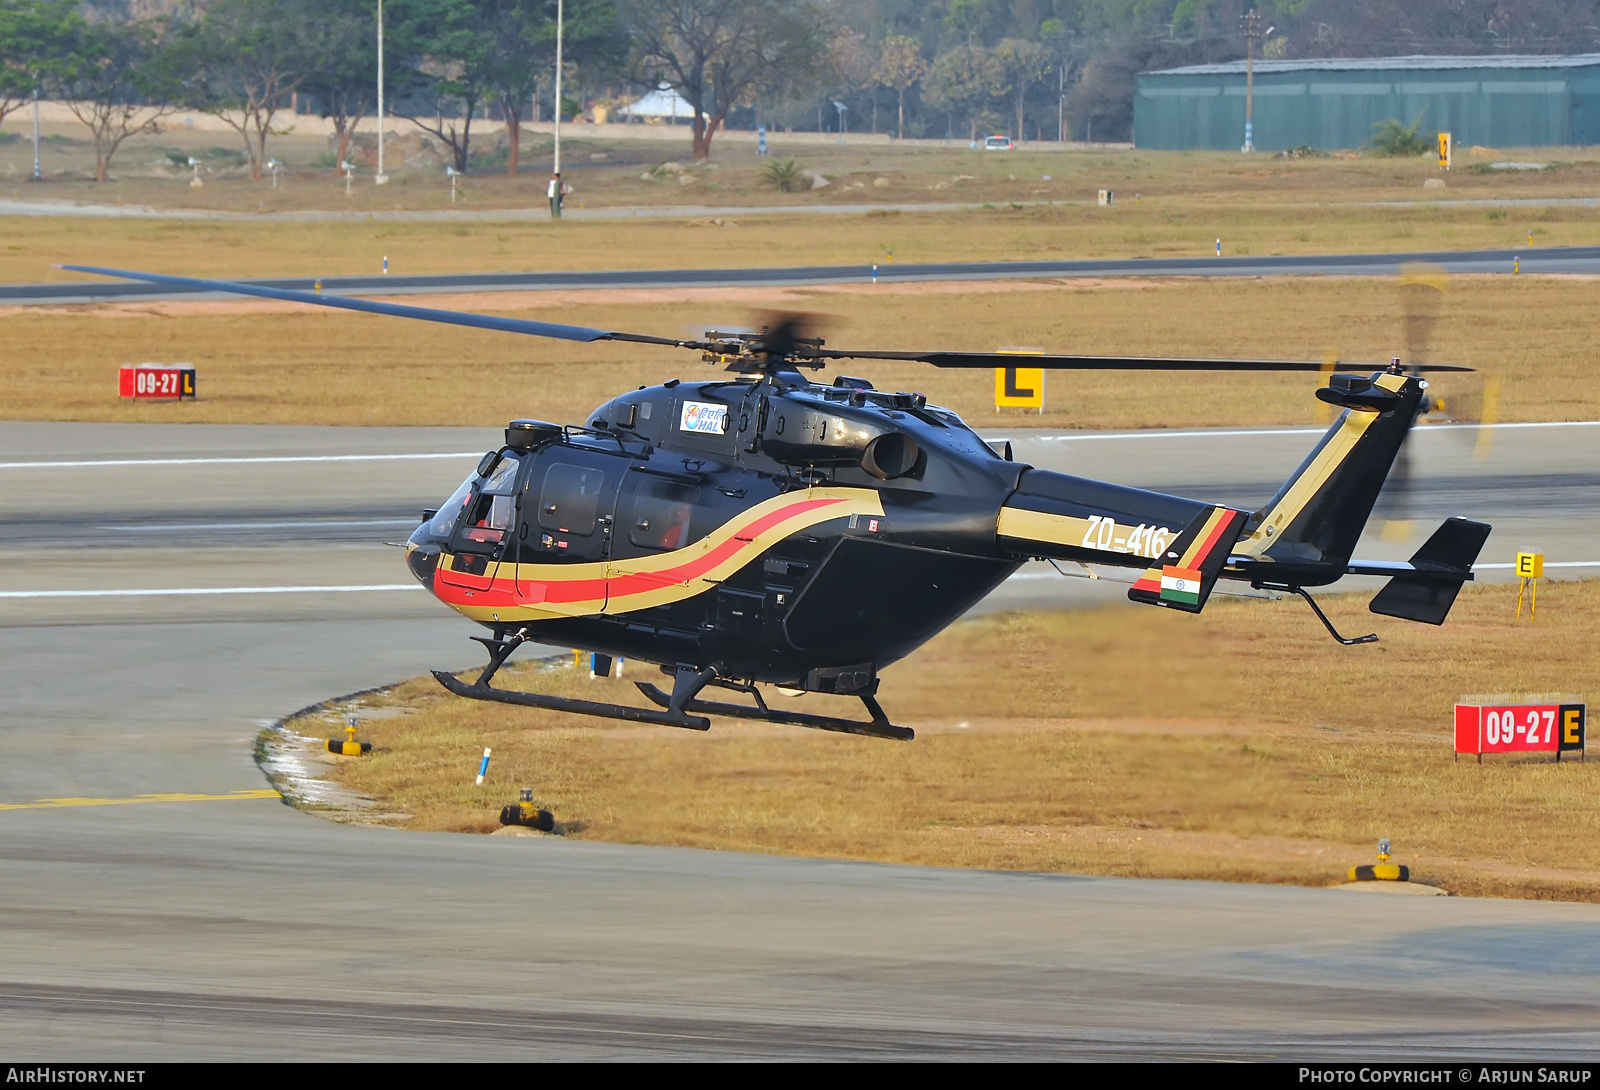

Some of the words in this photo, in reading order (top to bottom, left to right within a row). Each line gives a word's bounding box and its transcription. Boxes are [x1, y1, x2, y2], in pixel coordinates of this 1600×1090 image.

[137, 372, 178, 394] 09-27
[184, 373, 193, 394] L
[1005, 367, 1033, 397] L
[698, 420, 718, 432] HAL
[1081, 514, 1184, 560] ZD-416
[1520, 555, 1532, 573] E
[1487, 710, 1555, 745] 09-27
[1564, 710, 1580, 743] E
